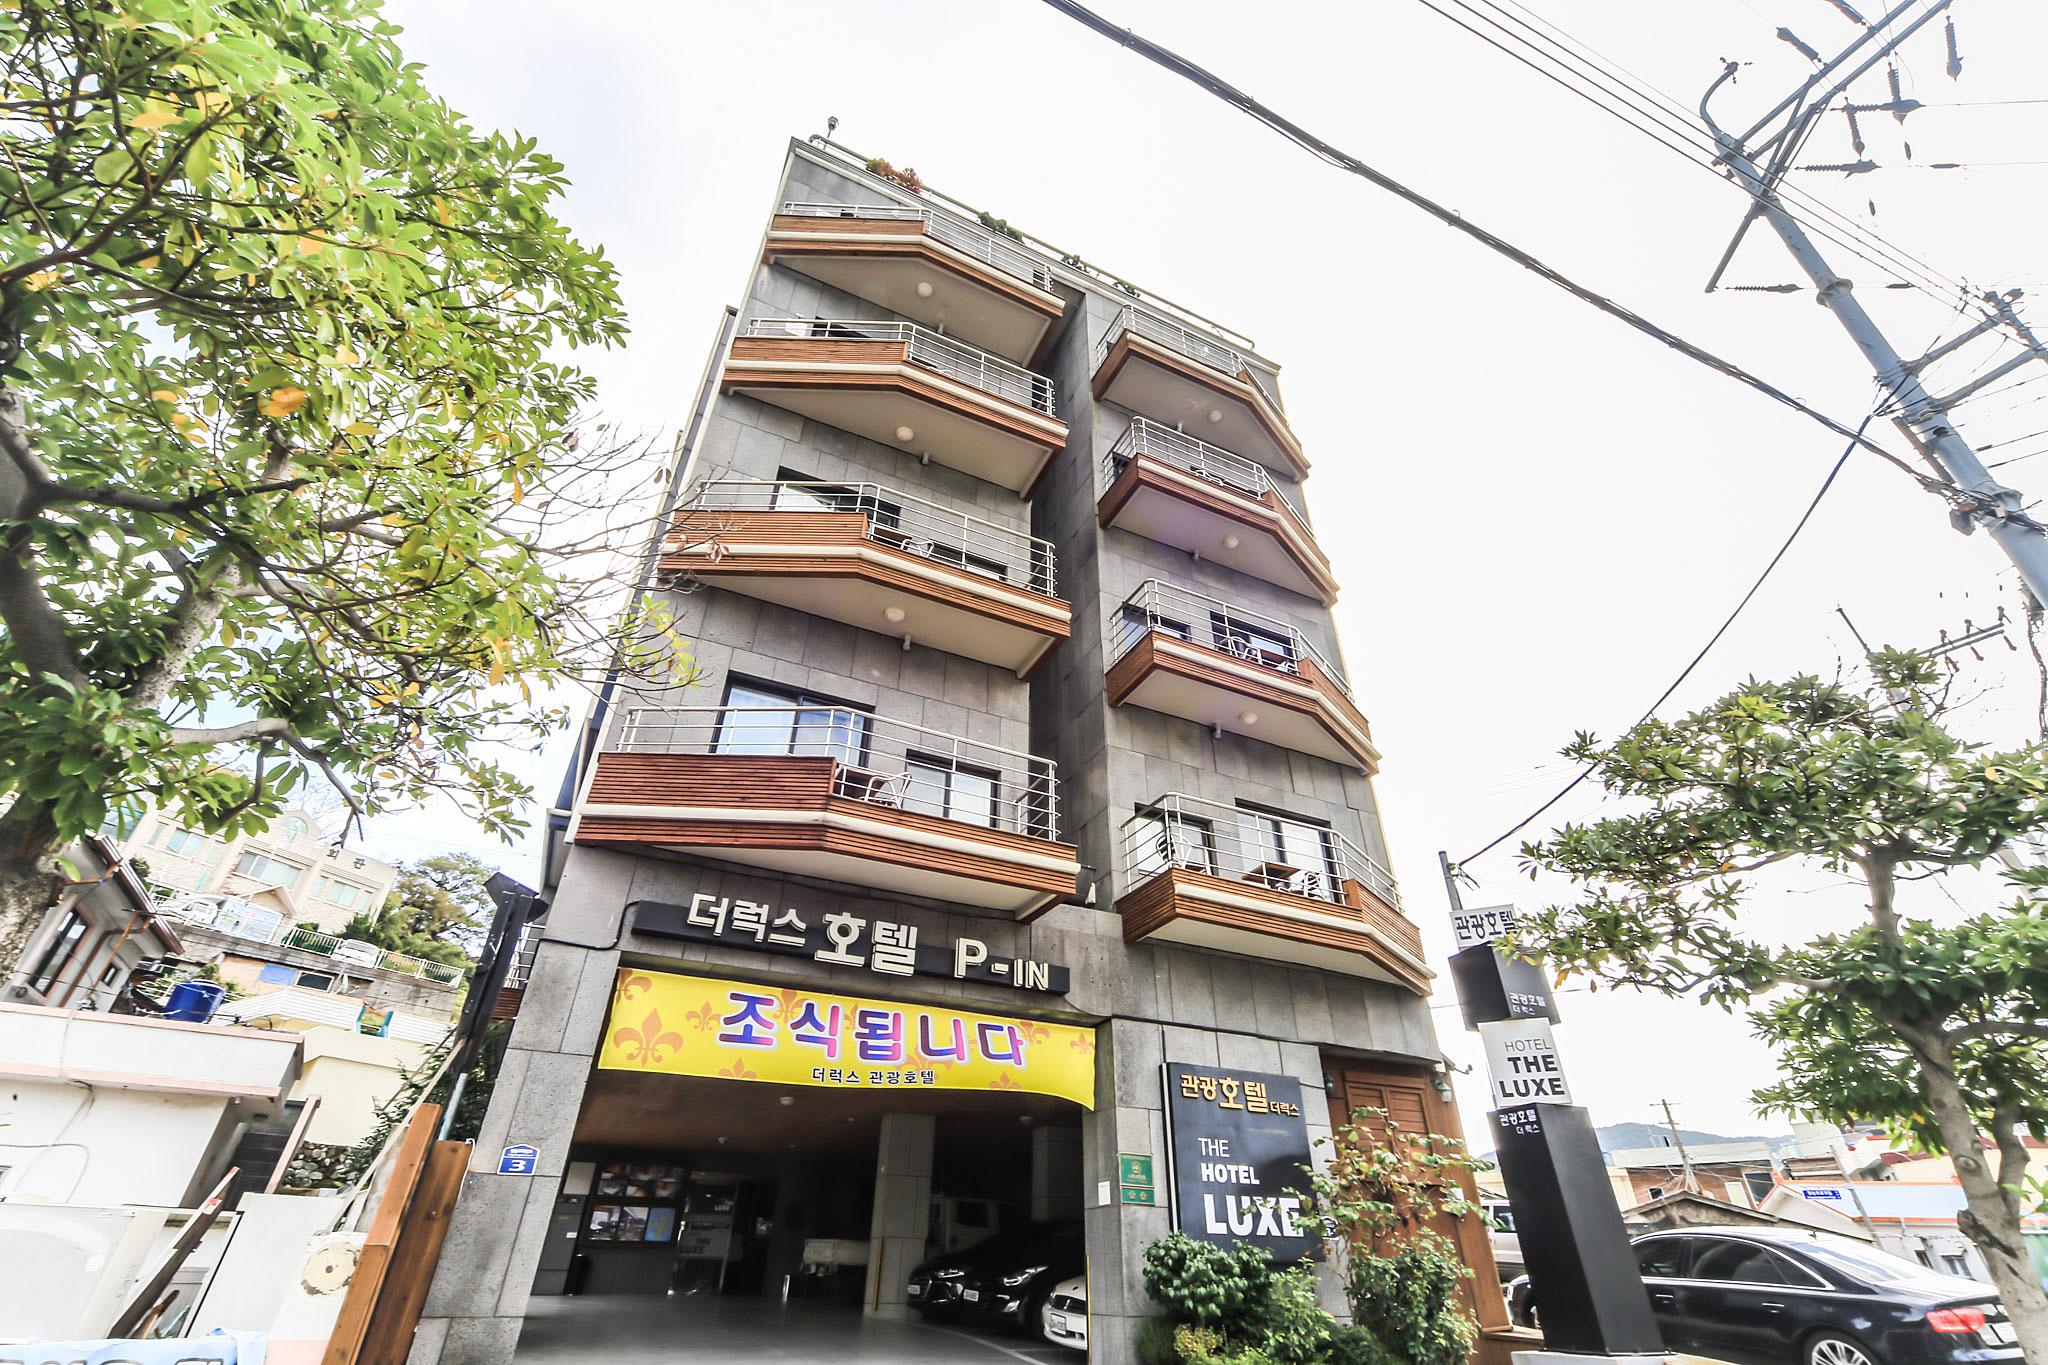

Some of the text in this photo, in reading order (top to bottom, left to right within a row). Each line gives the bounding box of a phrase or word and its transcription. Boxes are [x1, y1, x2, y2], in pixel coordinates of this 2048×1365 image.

[1454, 910, 1518, 940] 관광호텔
[687, 893, 1049, 991] 더럭스 호텔 P-IN
[718, 991, 1024, 1066] 조식됩니다
[1504, 1038, 1552, 1052] HOTEL
[1507, 1054, 1558, 1074] THE
[812, 1067, 934, 1085] 더럭스 관광호텔
[1180, 1074, 1301, 1117] 관광호텔 더럭스
[1499, 1077, 1565, 1098] LUXE
[1198, 1137, 1230, 1158] THE
[508, 1159, 527, 1172] 3
[1200, 1162, 1260, 1186] HOTEL
[1203, 1193, 1305, 1238] LUXE
